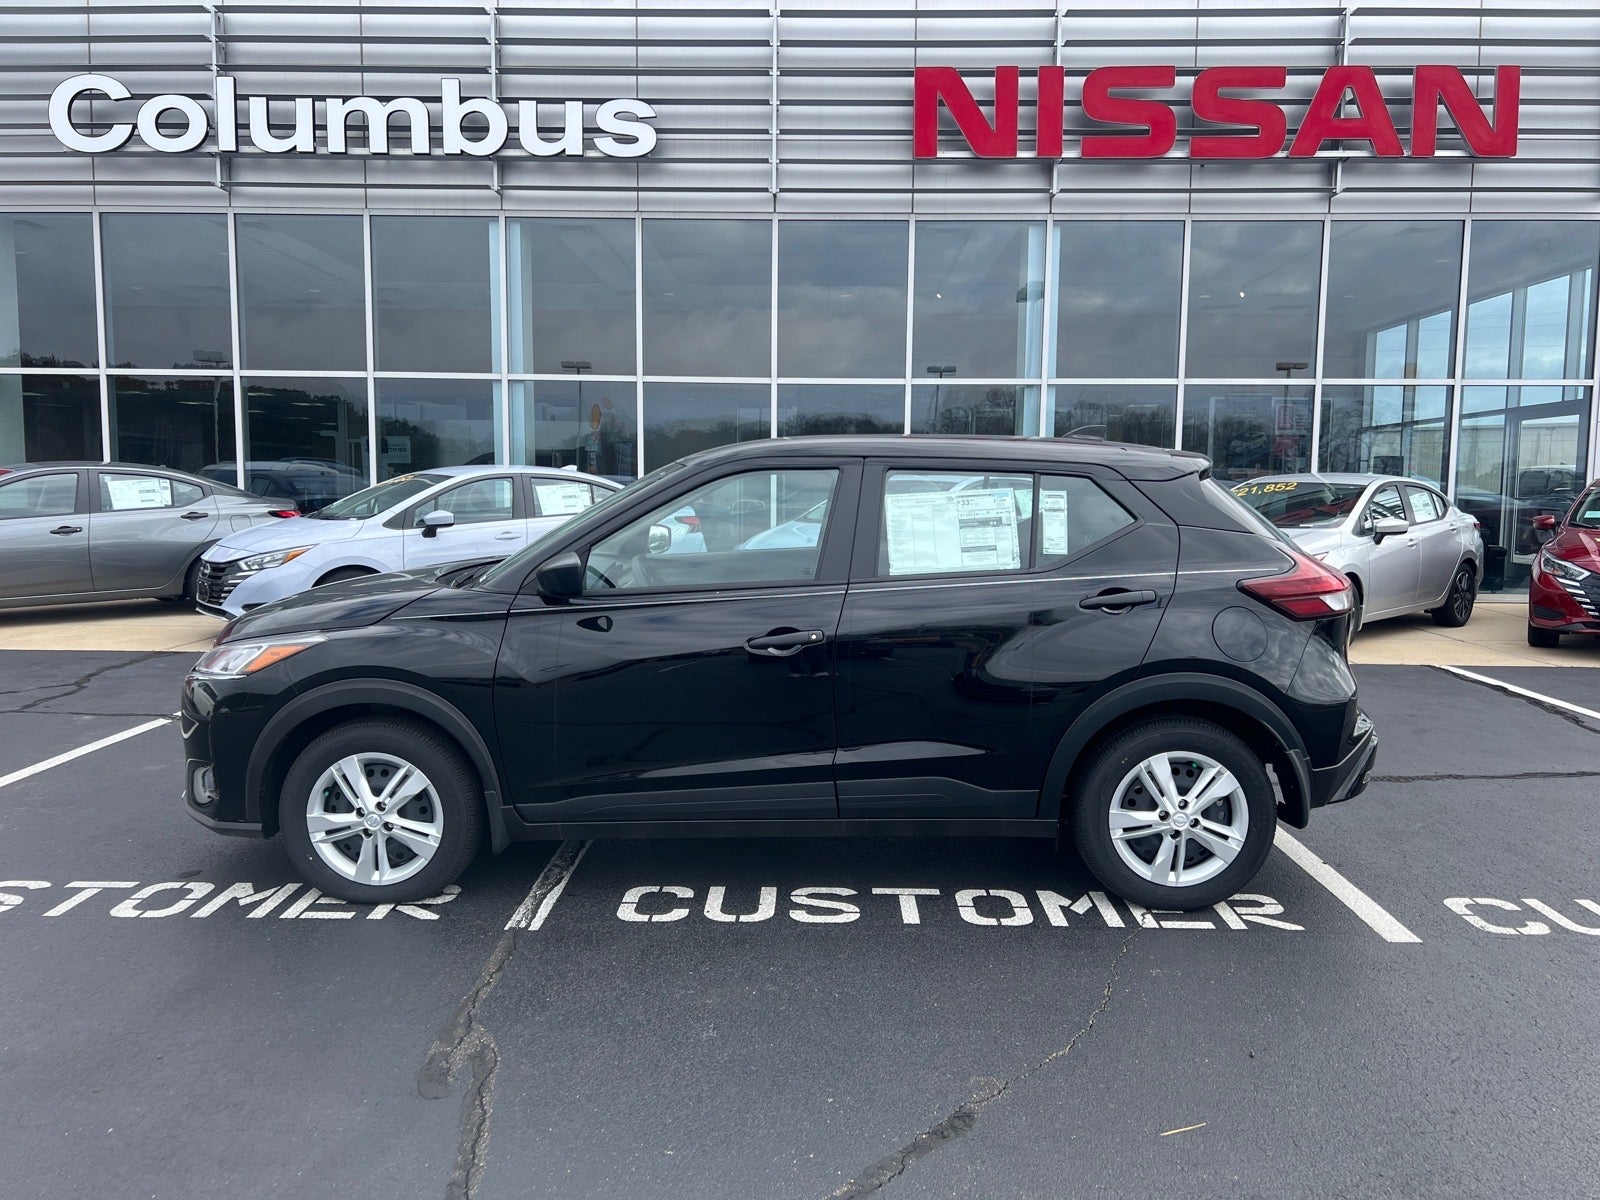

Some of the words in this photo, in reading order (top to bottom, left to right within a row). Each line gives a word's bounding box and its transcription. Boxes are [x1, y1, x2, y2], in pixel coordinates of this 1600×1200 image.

[48, 73, 657, 157] Columbus
[914, 65, 1521, 159] NISSAN
[616, 885, 1306, 931] CUSTOMER
[1443, 897, 1600, 936] CU
